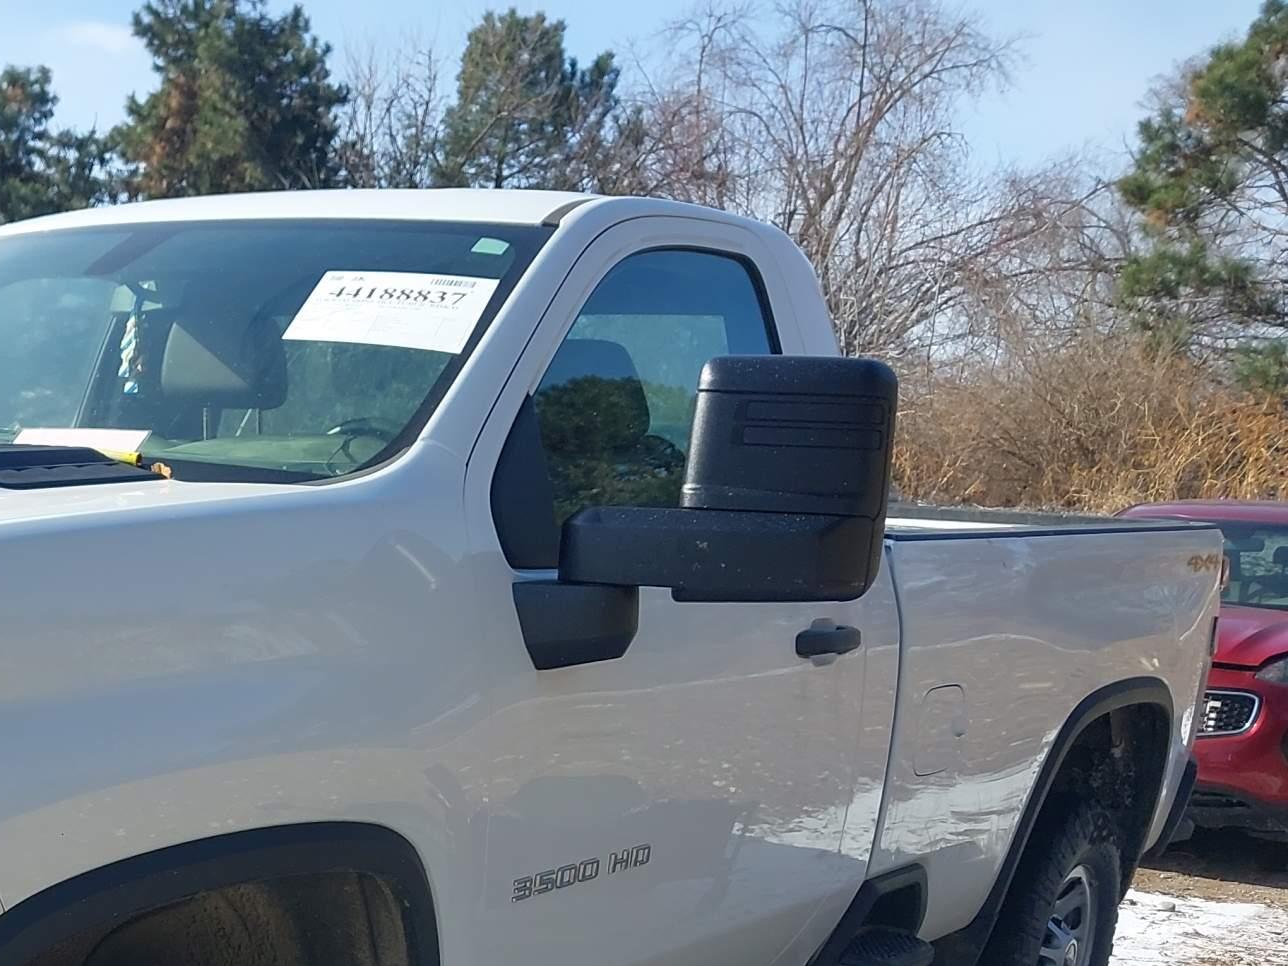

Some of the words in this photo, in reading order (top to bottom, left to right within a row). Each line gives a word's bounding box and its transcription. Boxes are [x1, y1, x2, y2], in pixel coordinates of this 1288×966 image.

[328, 286, 467, 305] 44188837
[511, 857, 601, 903] 3500
[607, 843, 652, 875] HD
